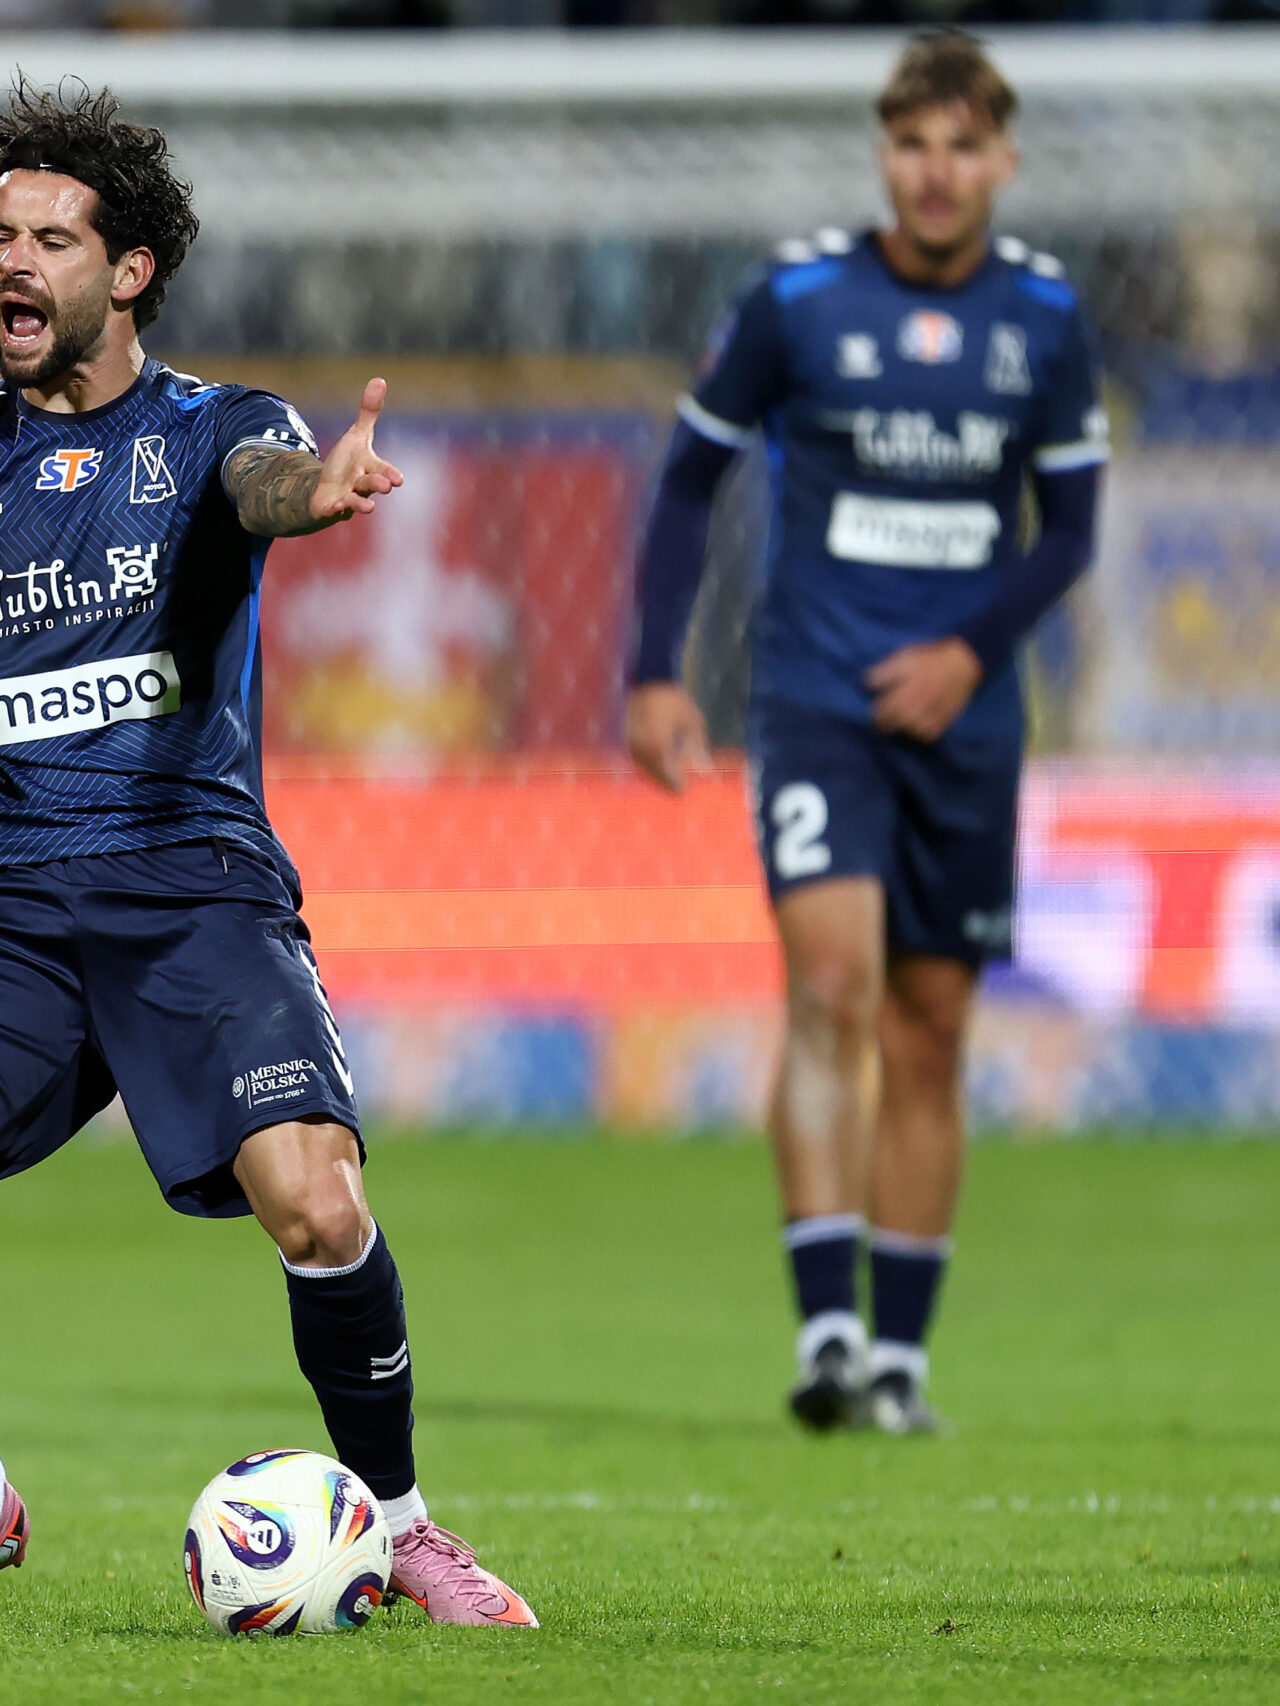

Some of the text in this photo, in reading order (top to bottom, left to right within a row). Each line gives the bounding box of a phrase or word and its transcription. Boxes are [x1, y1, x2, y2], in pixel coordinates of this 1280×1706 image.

[35, 447, 103, 492] STS
[65, 599, 155, 627] INSPIRACJI
[772, 781, 832, 880] 2
[249, 1059, 319, 1083] MENNICA
[250, 1072, 310, 1096] POLSKA
